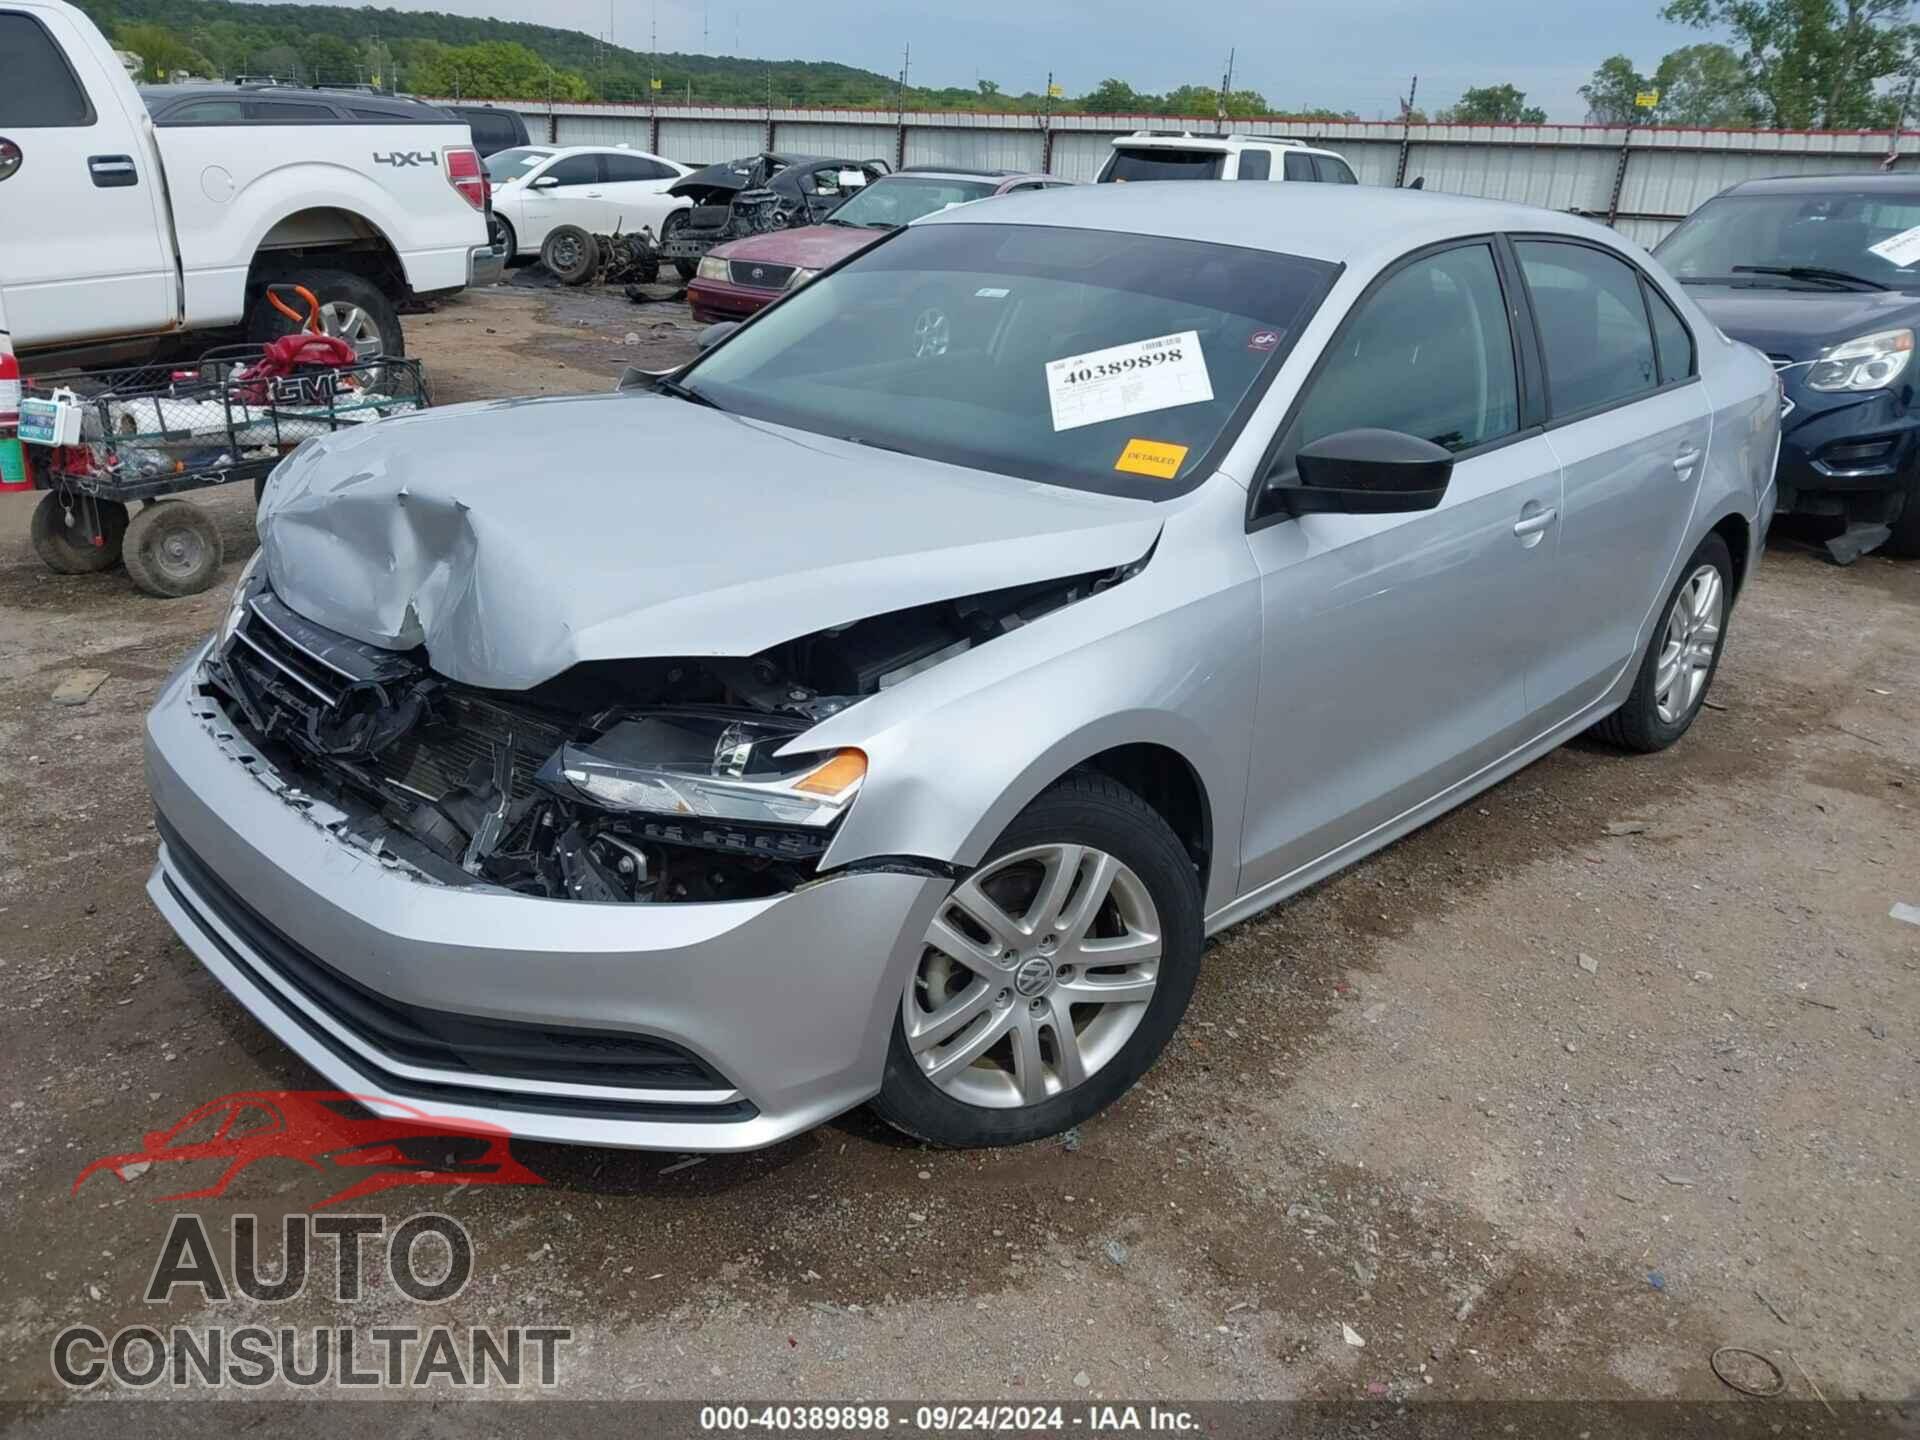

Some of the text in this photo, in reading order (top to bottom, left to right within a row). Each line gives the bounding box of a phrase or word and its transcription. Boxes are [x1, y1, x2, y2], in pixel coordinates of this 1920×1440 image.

[1064, 348, 1183, 384] 40389898
[272, 371, 354, 404] GMC
[1127, 452, 1176, 465] DETAILED
